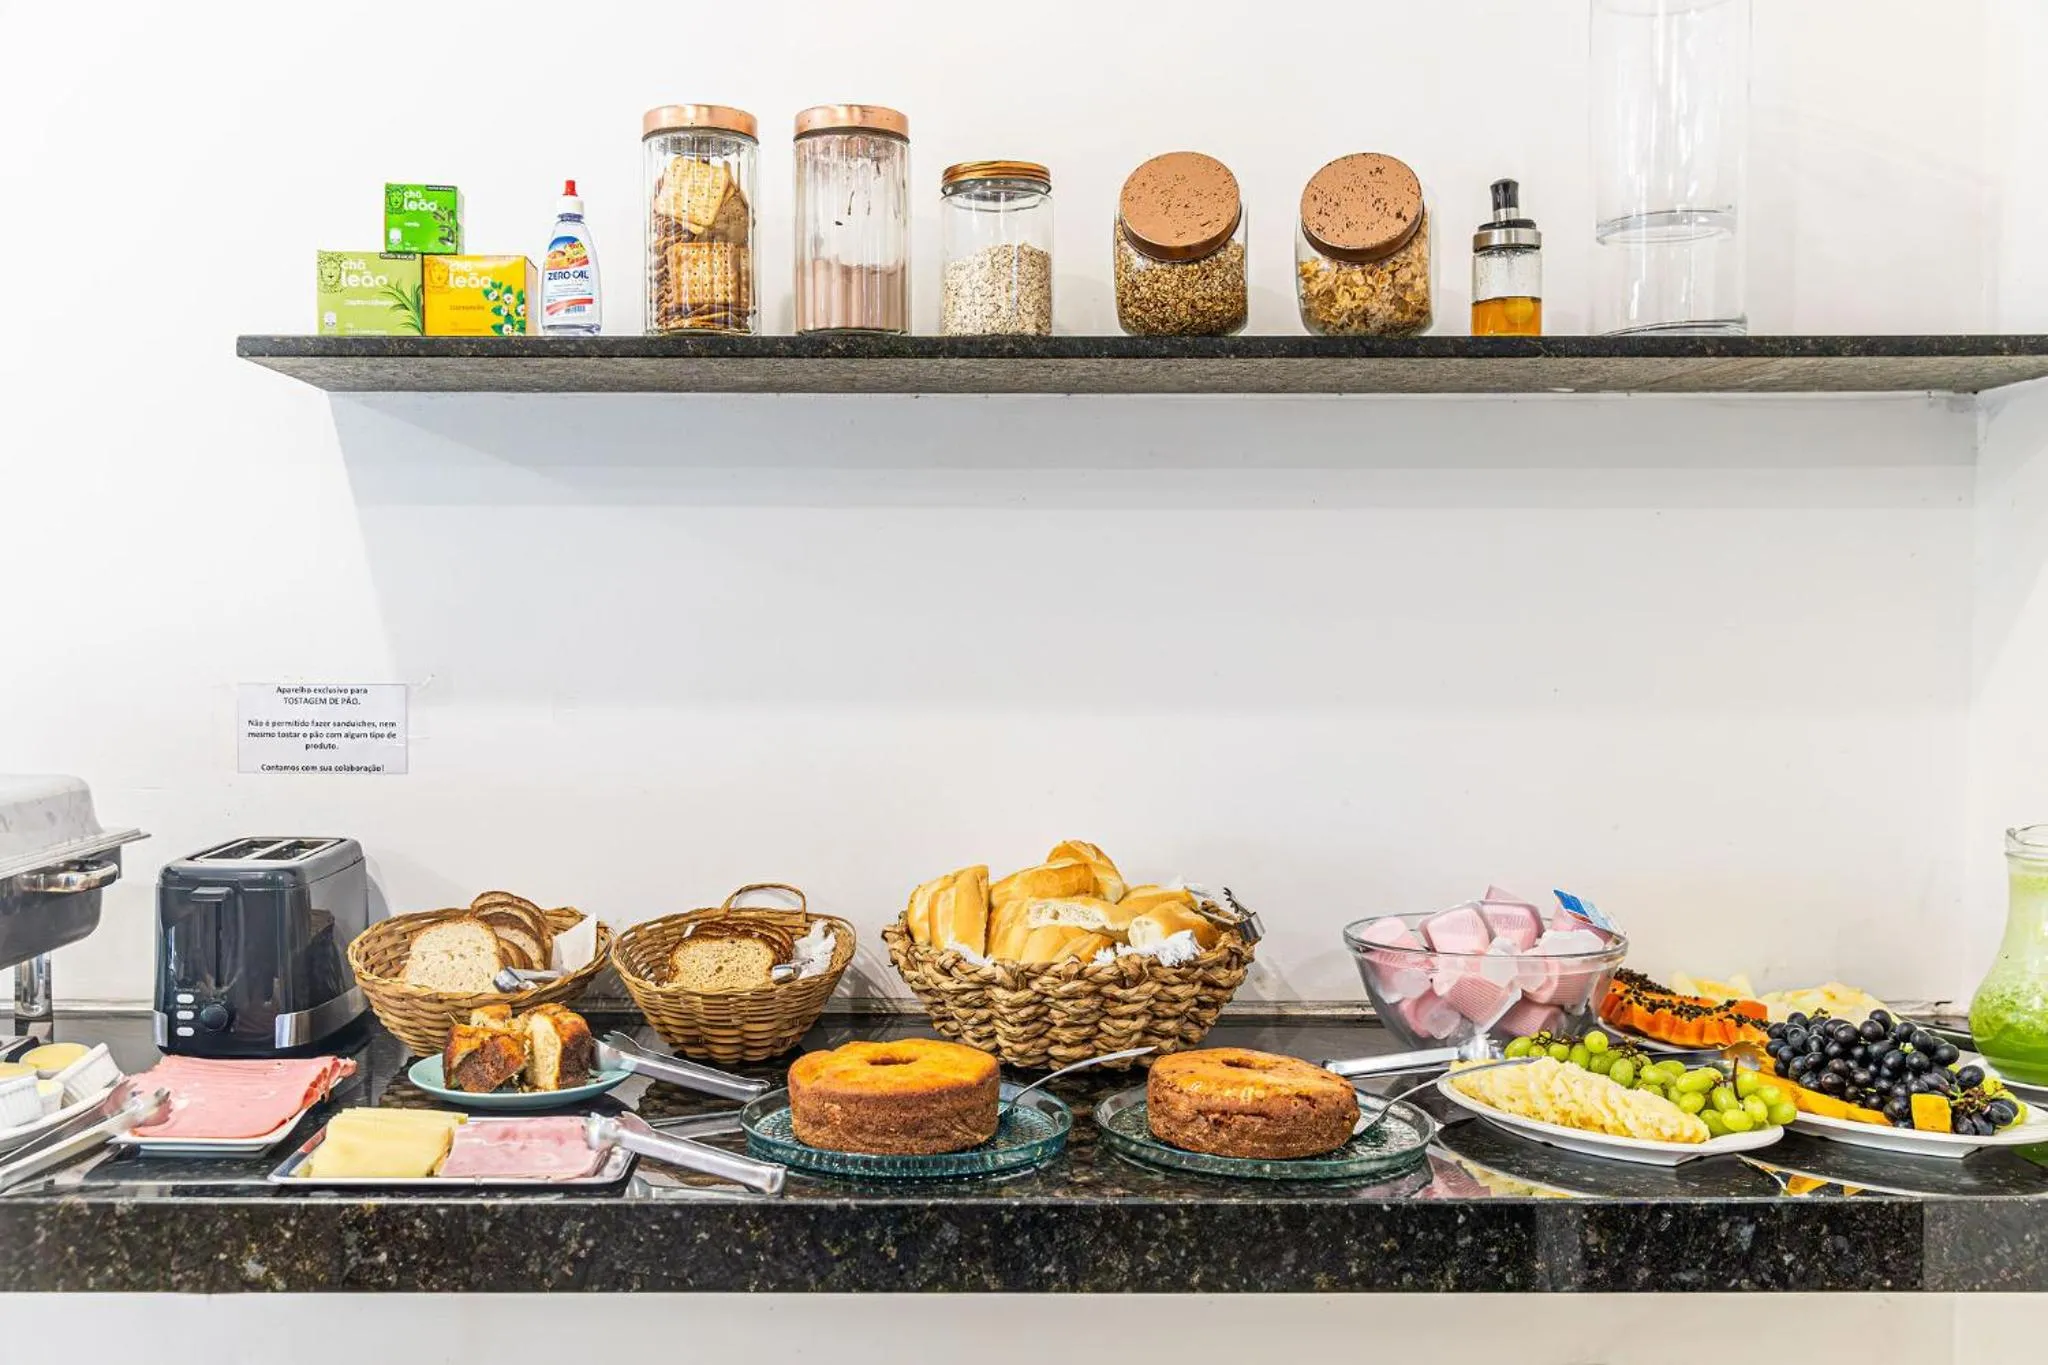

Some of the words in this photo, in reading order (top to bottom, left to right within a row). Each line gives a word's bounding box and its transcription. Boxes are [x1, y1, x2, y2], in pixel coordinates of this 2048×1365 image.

[404, 198, 437, 211] leão
[341, 270, 388, 287] leão
[449, 272, 492, 288] leão
[276, 686, 312, 694] Aparelho
[283, 697, 327, 705] TOSTAGEM
[328, 697, 340, 705] DE
[340, 696, 361, 705] PÃO.
[248, 719, 264, 727] Não
[271, 719, 310, 728] permitido
[311, 719, 331, 727] fazer
[309, 731, 324, 739] pão
[343, 731, 368, 740] algum
[369, 731, 385, 740] tipo
[386, 731, 397, 739] de
[305, 742, 339, 751] produto.
[261, 763, 300, 771] Contamos
[319, 764, 333, 772] sua
[334, 763, 385, 773] colaboração!
